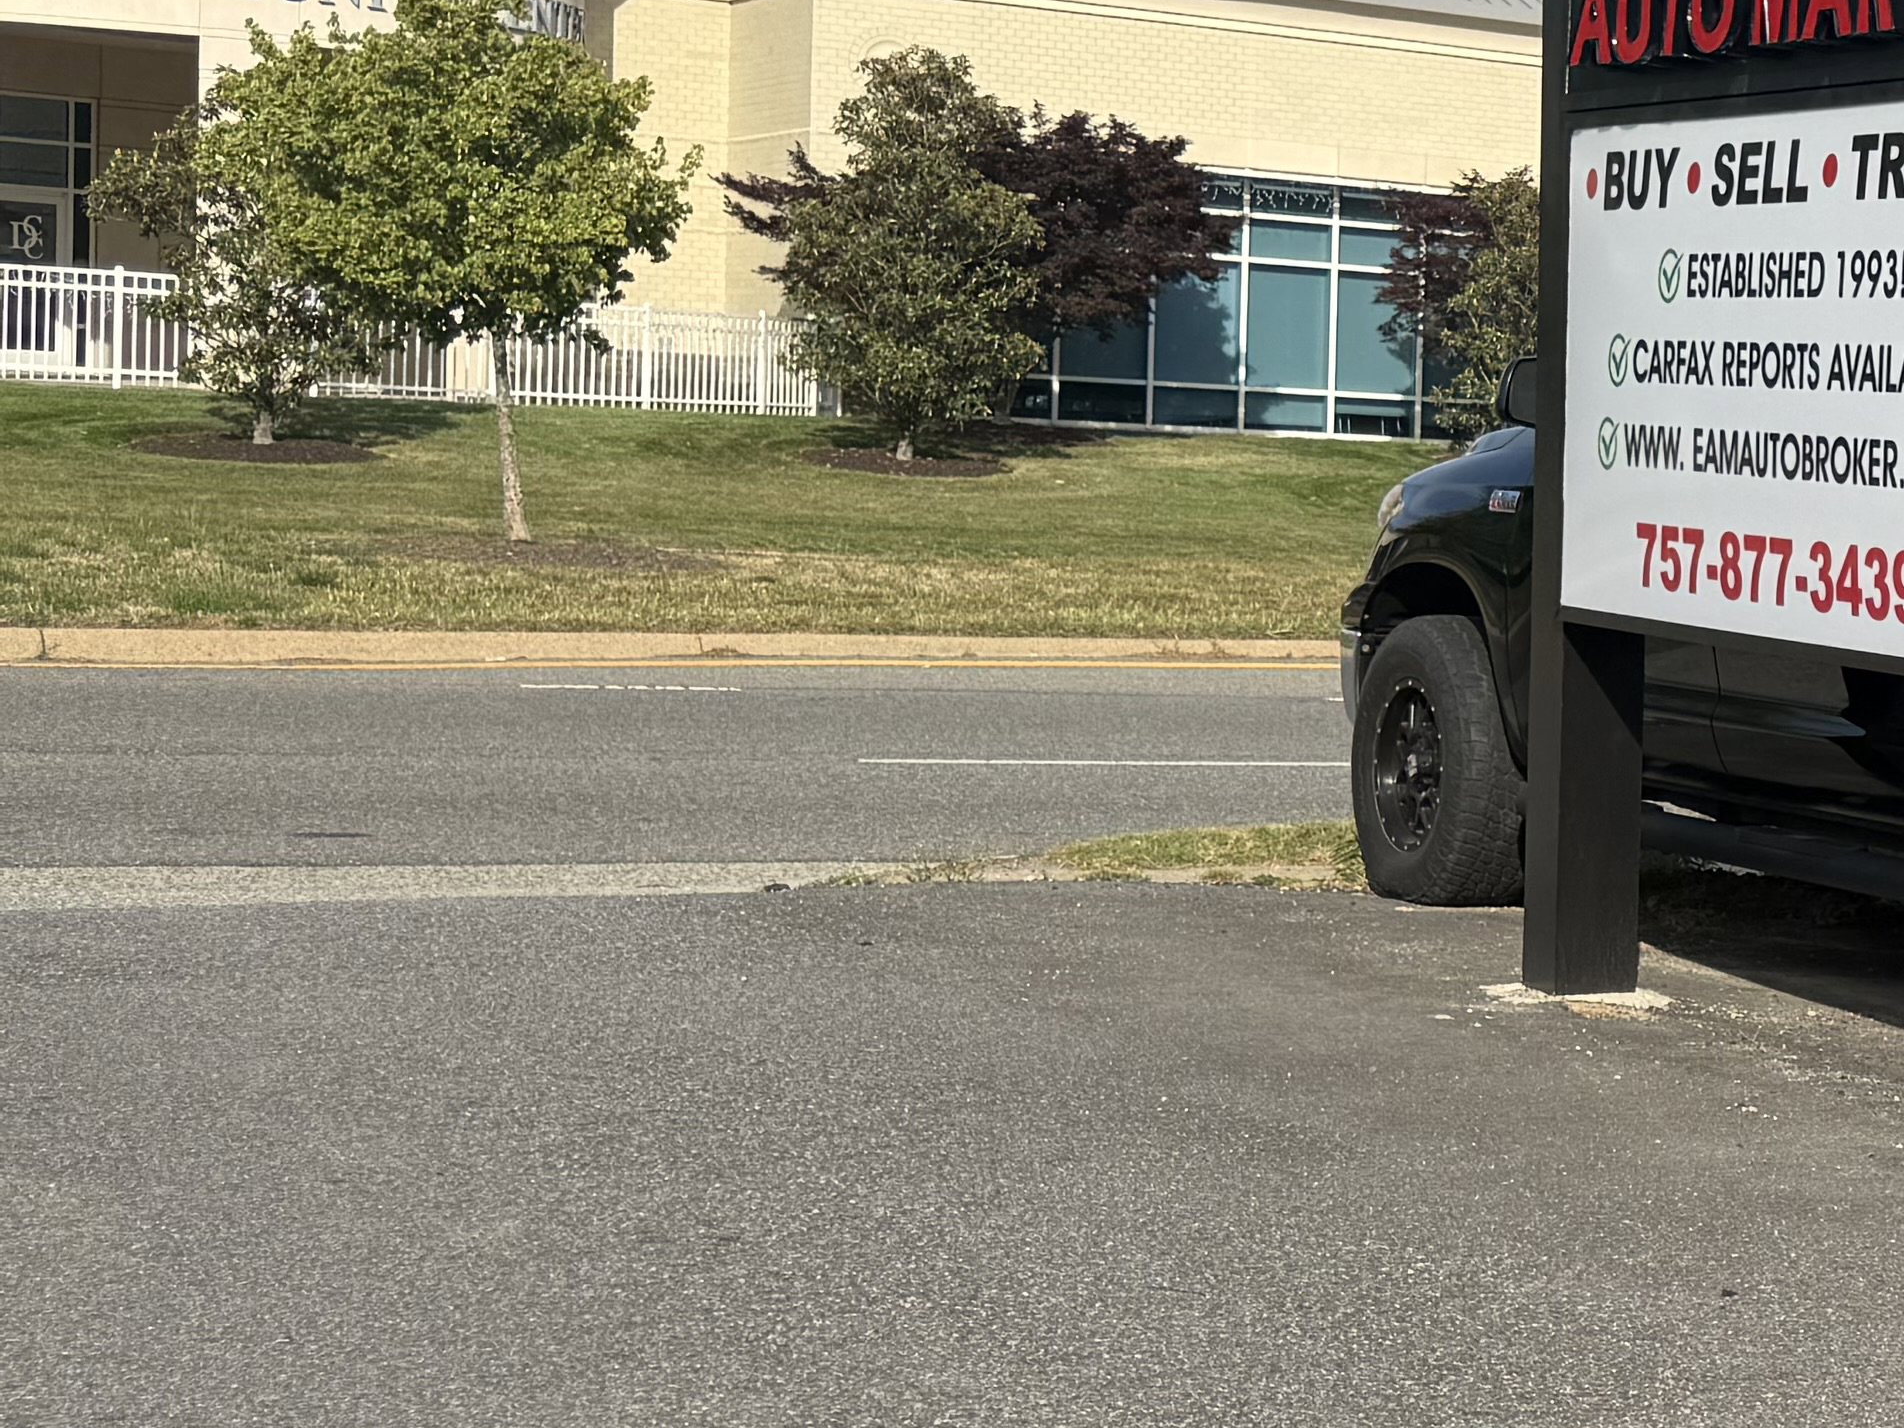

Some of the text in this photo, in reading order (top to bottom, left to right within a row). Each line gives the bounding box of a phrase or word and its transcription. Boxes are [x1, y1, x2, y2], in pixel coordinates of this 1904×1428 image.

[1603, 146, 1681, 211] BUY
[1711, 138, 1809, 207] SELL
[1687, 251, 1825, 299] ESTABLISHED
[1632, 340, 1714, 386] CARFAX
[1722, 341, 1819, 391] REPORTS
[1624, 424, 1685, 471] WWW.
